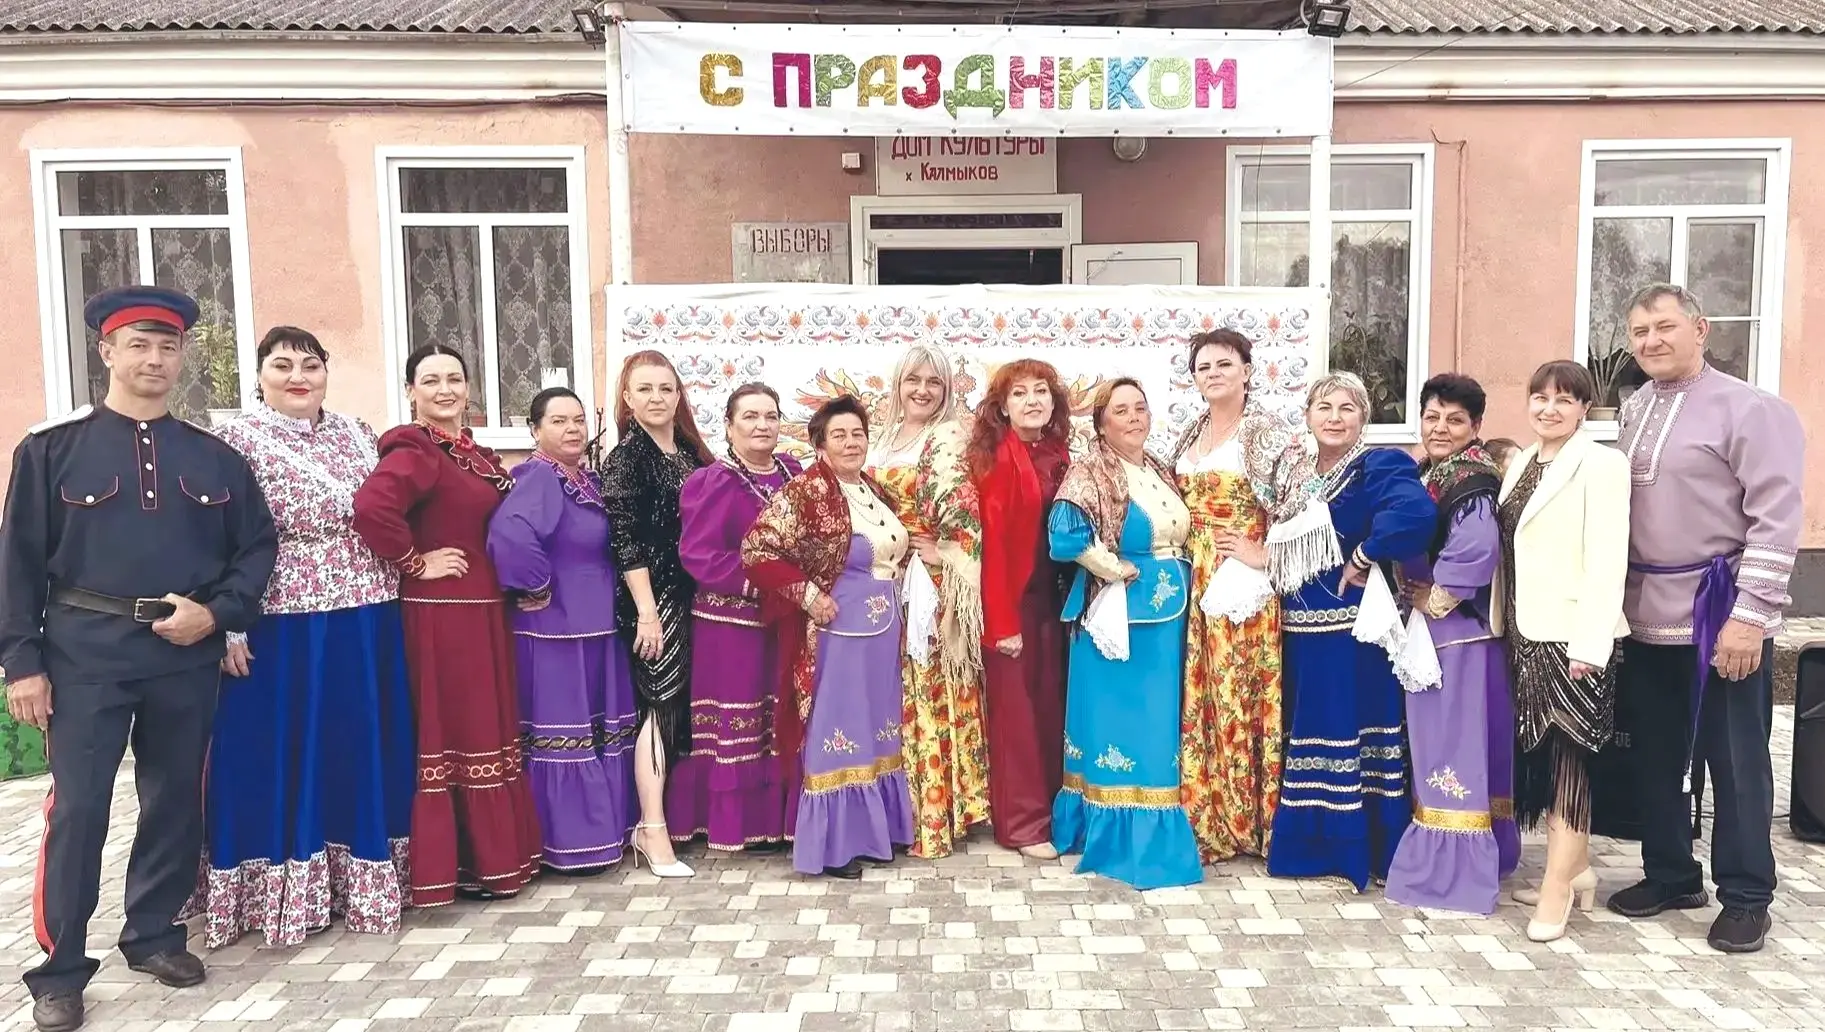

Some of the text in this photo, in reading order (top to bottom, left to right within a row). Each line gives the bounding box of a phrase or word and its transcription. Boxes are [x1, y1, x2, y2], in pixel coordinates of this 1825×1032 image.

[700, 52, 1237, 120] С ПРАЗДНИКОМ
[752, 228, 831, 254] ВЫБОРЫ
